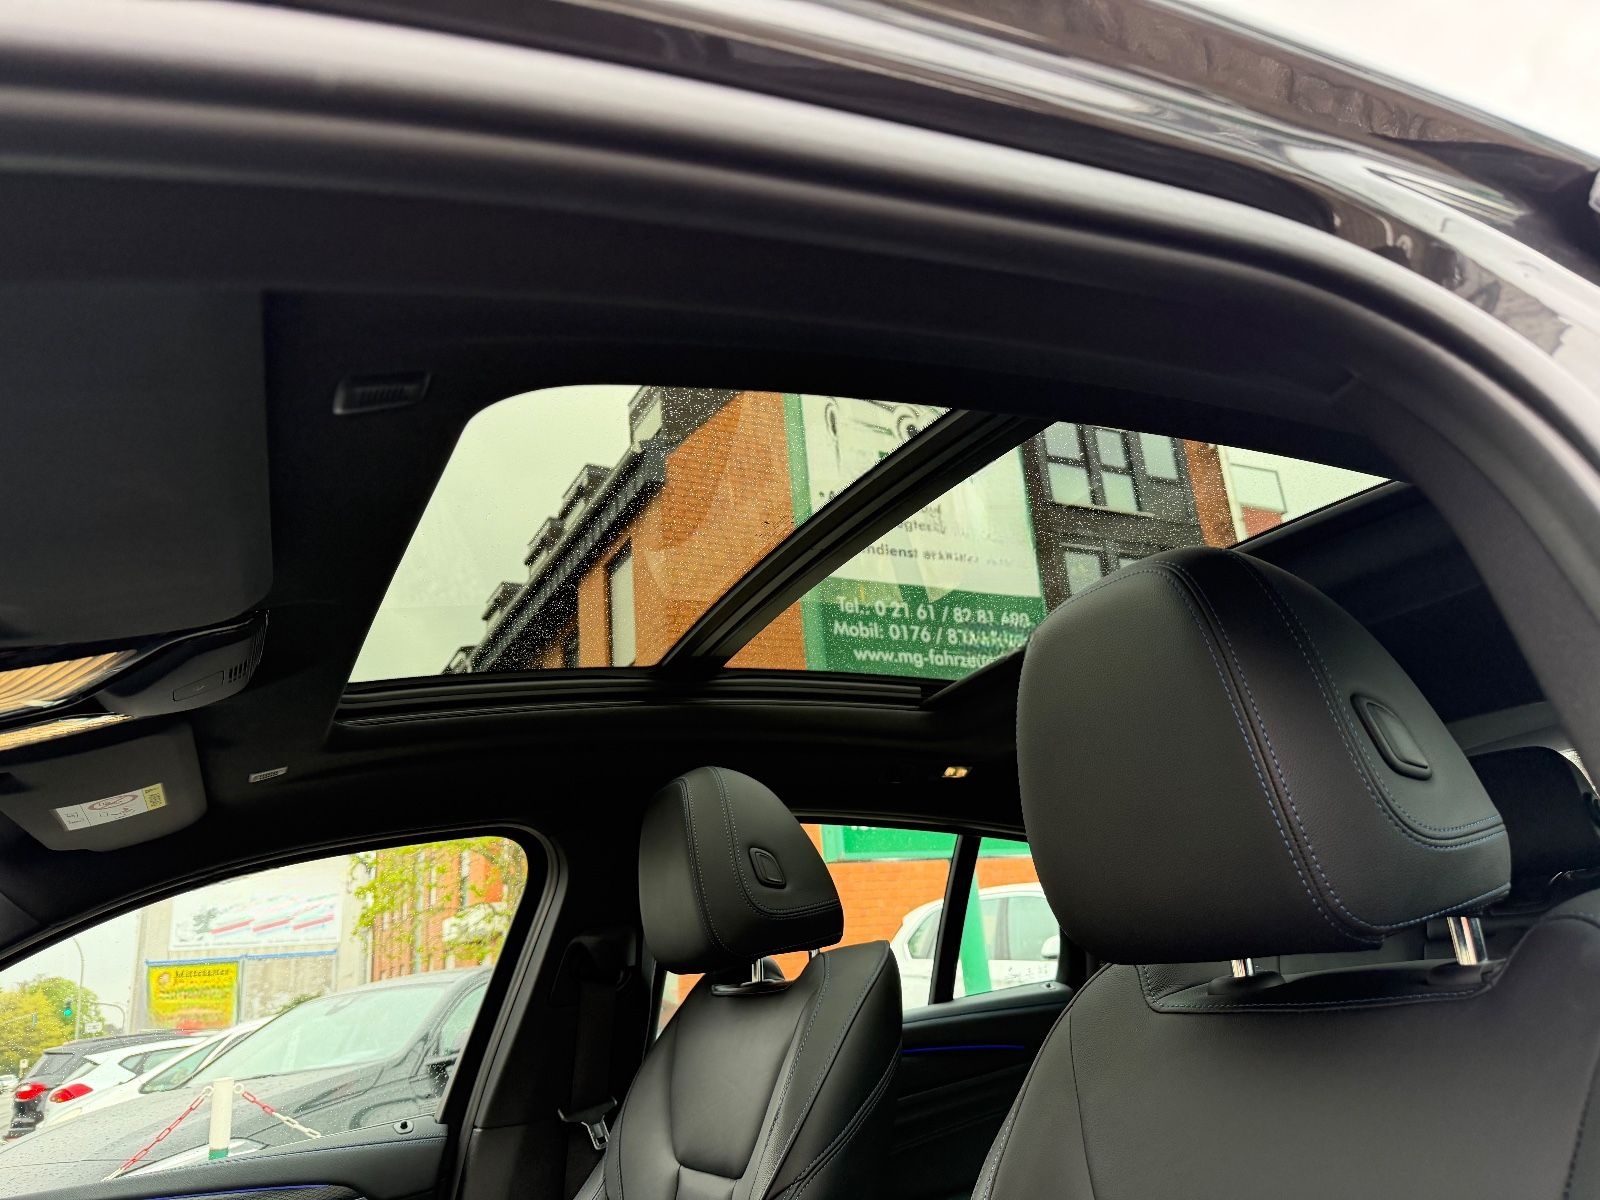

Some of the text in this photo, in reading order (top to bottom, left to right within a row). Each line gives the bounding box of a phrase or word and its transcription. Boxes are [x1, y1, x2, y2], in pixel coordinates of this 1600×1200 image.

[862, 543, 918, 559] ndienst
[874, 600, 887, 617] 0
[891, 601, 910, 618] 21
[916, 603, 935, 621] 61
[833, 620, 884, 639] Mobil:
[889, 624, 931, 643] 0176
